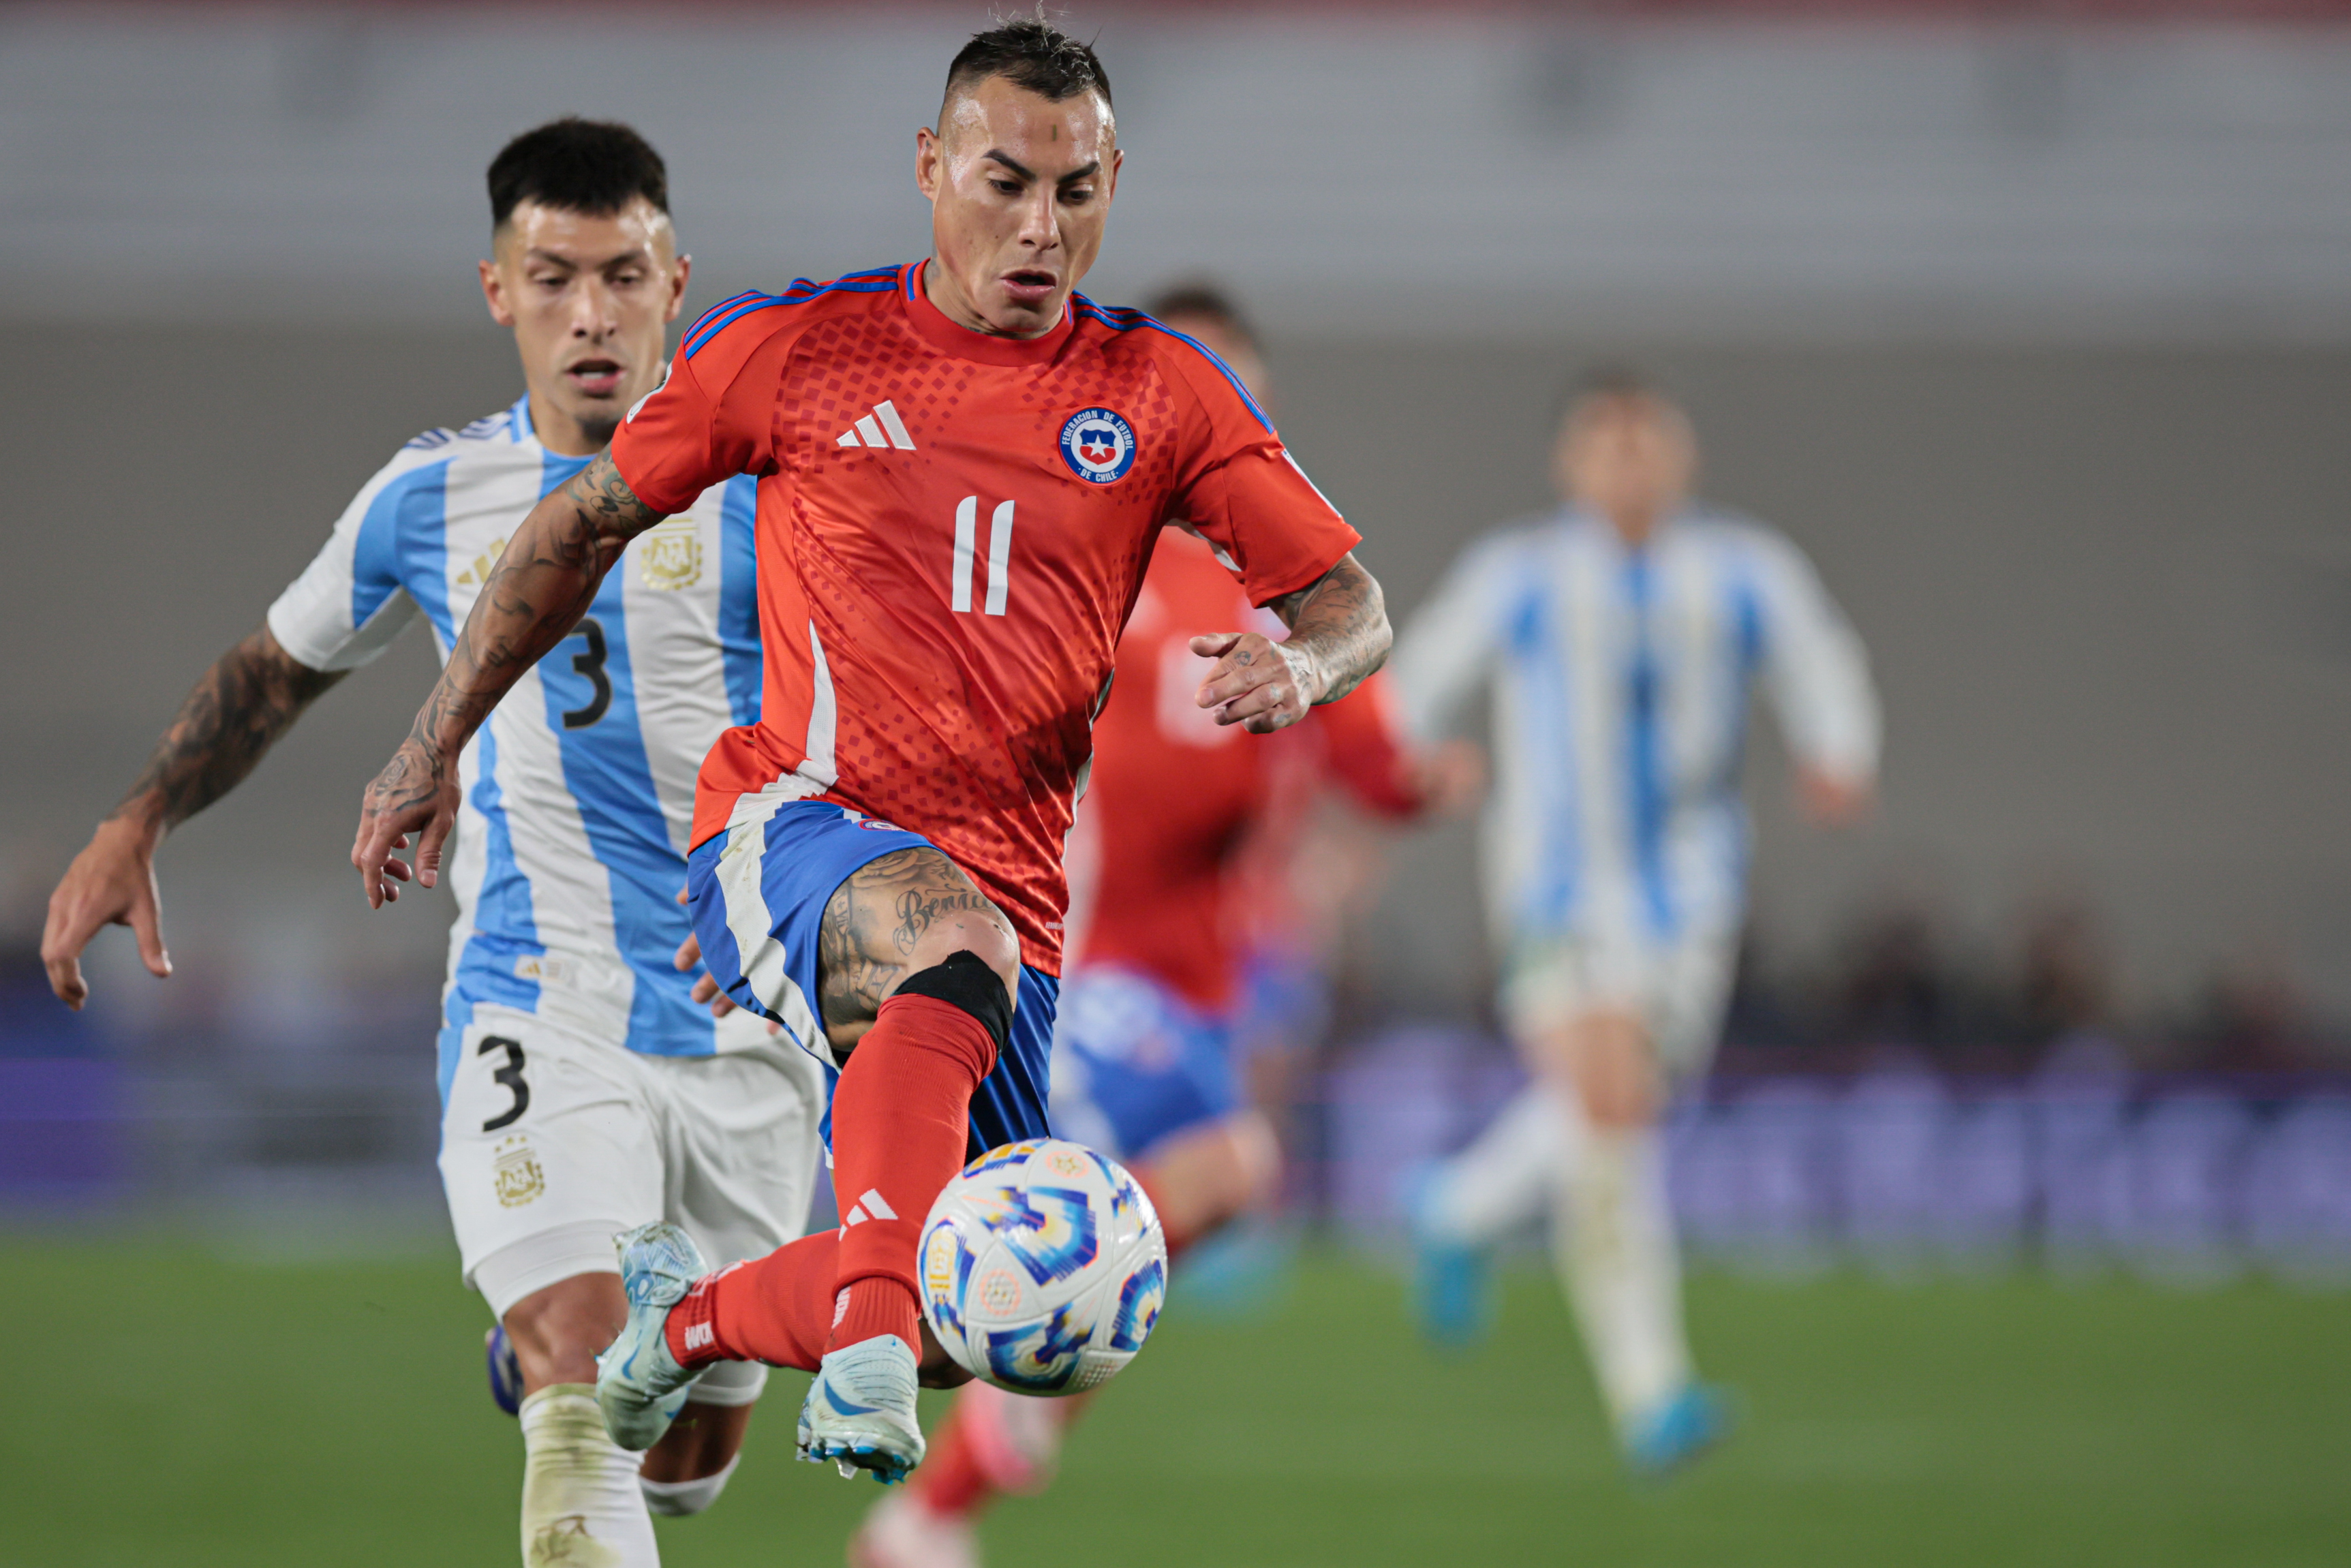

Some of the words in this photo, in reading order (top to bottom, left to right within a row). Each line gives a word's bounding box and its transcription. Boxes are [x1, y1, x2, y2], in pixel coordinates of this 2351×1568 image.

[1062, 410, 1098, 445] FEDERACION
[1103, 411, 1115, 422] DE
[1116, 420, 1133, 450] FUTBOL
[1080, 468, 1092, 480] DE
[1095, 471, 1117, 482] CHILE
[952, 495, 1015, 616] 11
[563, 618, 611, 728] 3
[477, 1035, 529, 1132] 3
